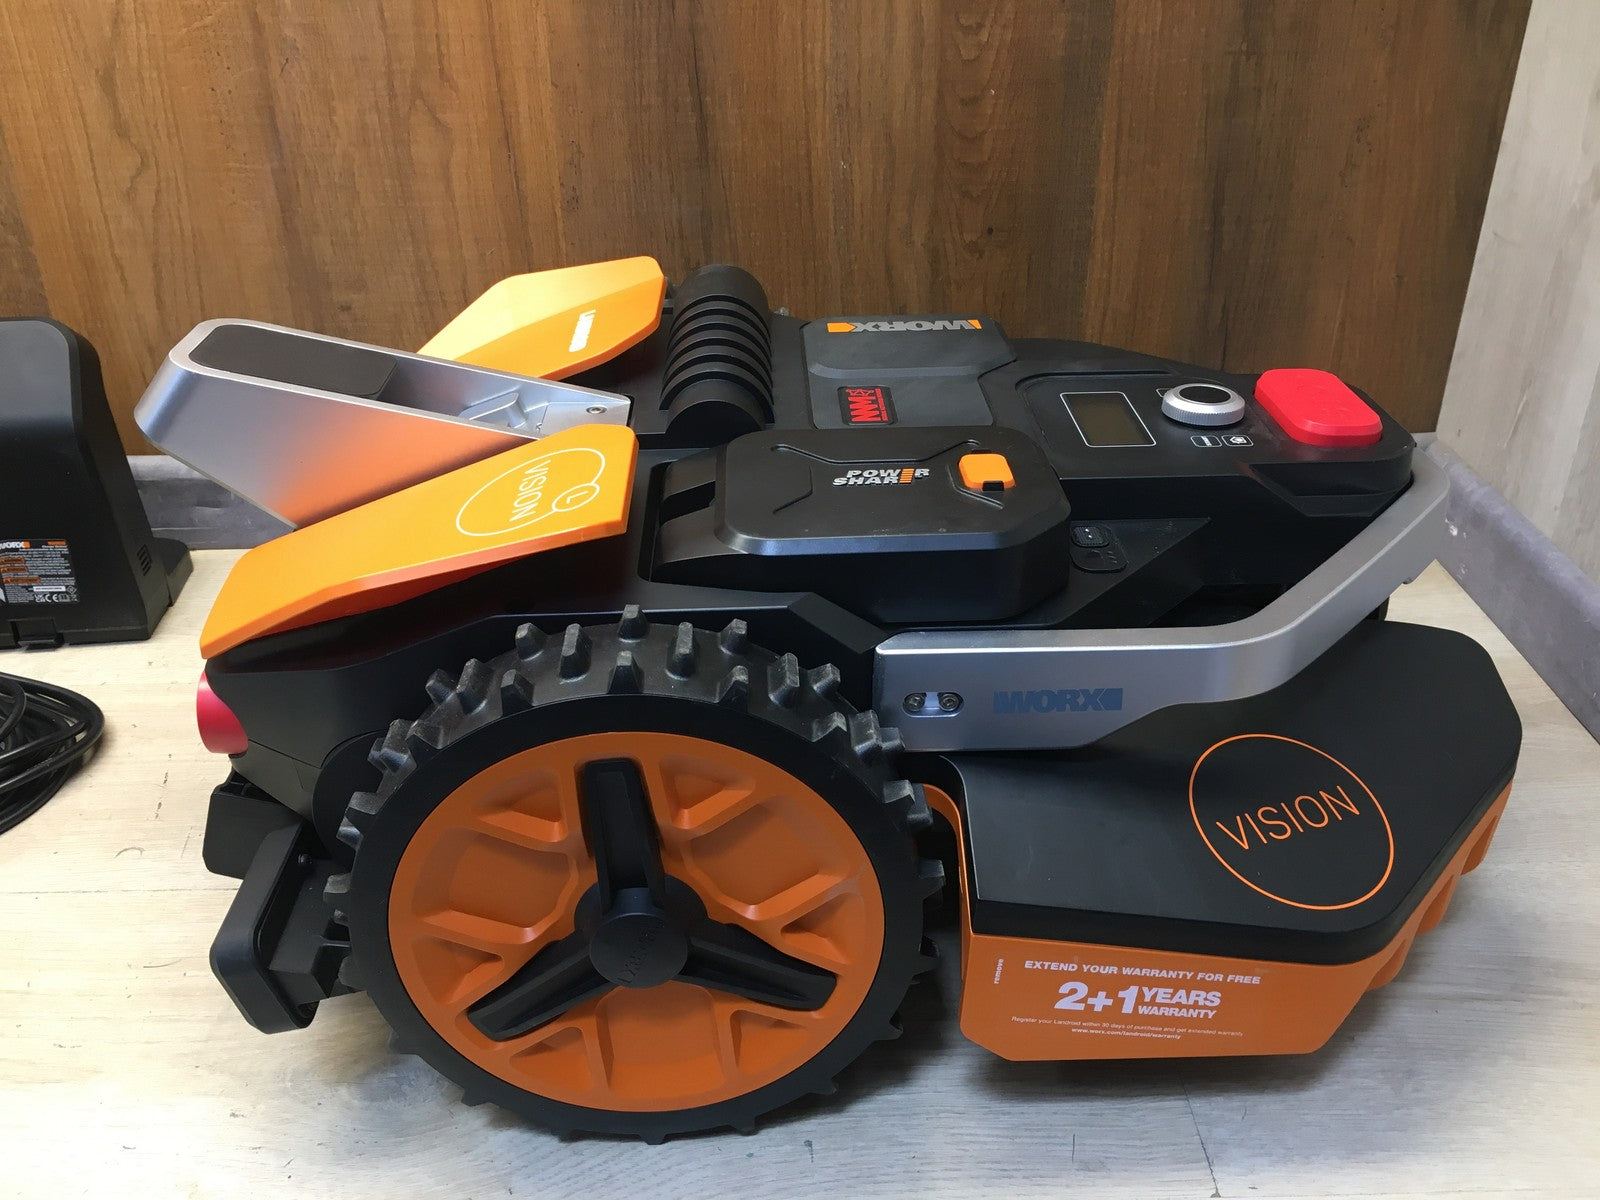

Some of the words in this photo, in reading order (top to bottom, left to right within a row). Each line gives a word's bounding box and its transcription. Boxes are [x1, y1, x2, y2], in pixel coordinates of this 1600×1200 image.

[854, 319, 982, 332] WORX
[832, 476, 914, 486] SHARE
[846, 468, 930, 478] POWER
[509, 459, 552, 522] VISION
[566, 490, 589, 504] L
[993, 689, 1106, 714] WORX
[1215, 785, 1360, 850] VISION
[1024, 960, 1079, 972] EXTEND
[1082, 964, 1119, 975] YOUR
[1122, 967, 1194, 980] WARRANTY
[1197, 972, 1224, 982] FOR
[1227, 974, 1261, 985] FREE
[1053, 981, 1140, 1014] 2+1
[1141, 986, 1222, 1007] YEARS
[1138, 1005, 1217, 1019] WARRANTY
